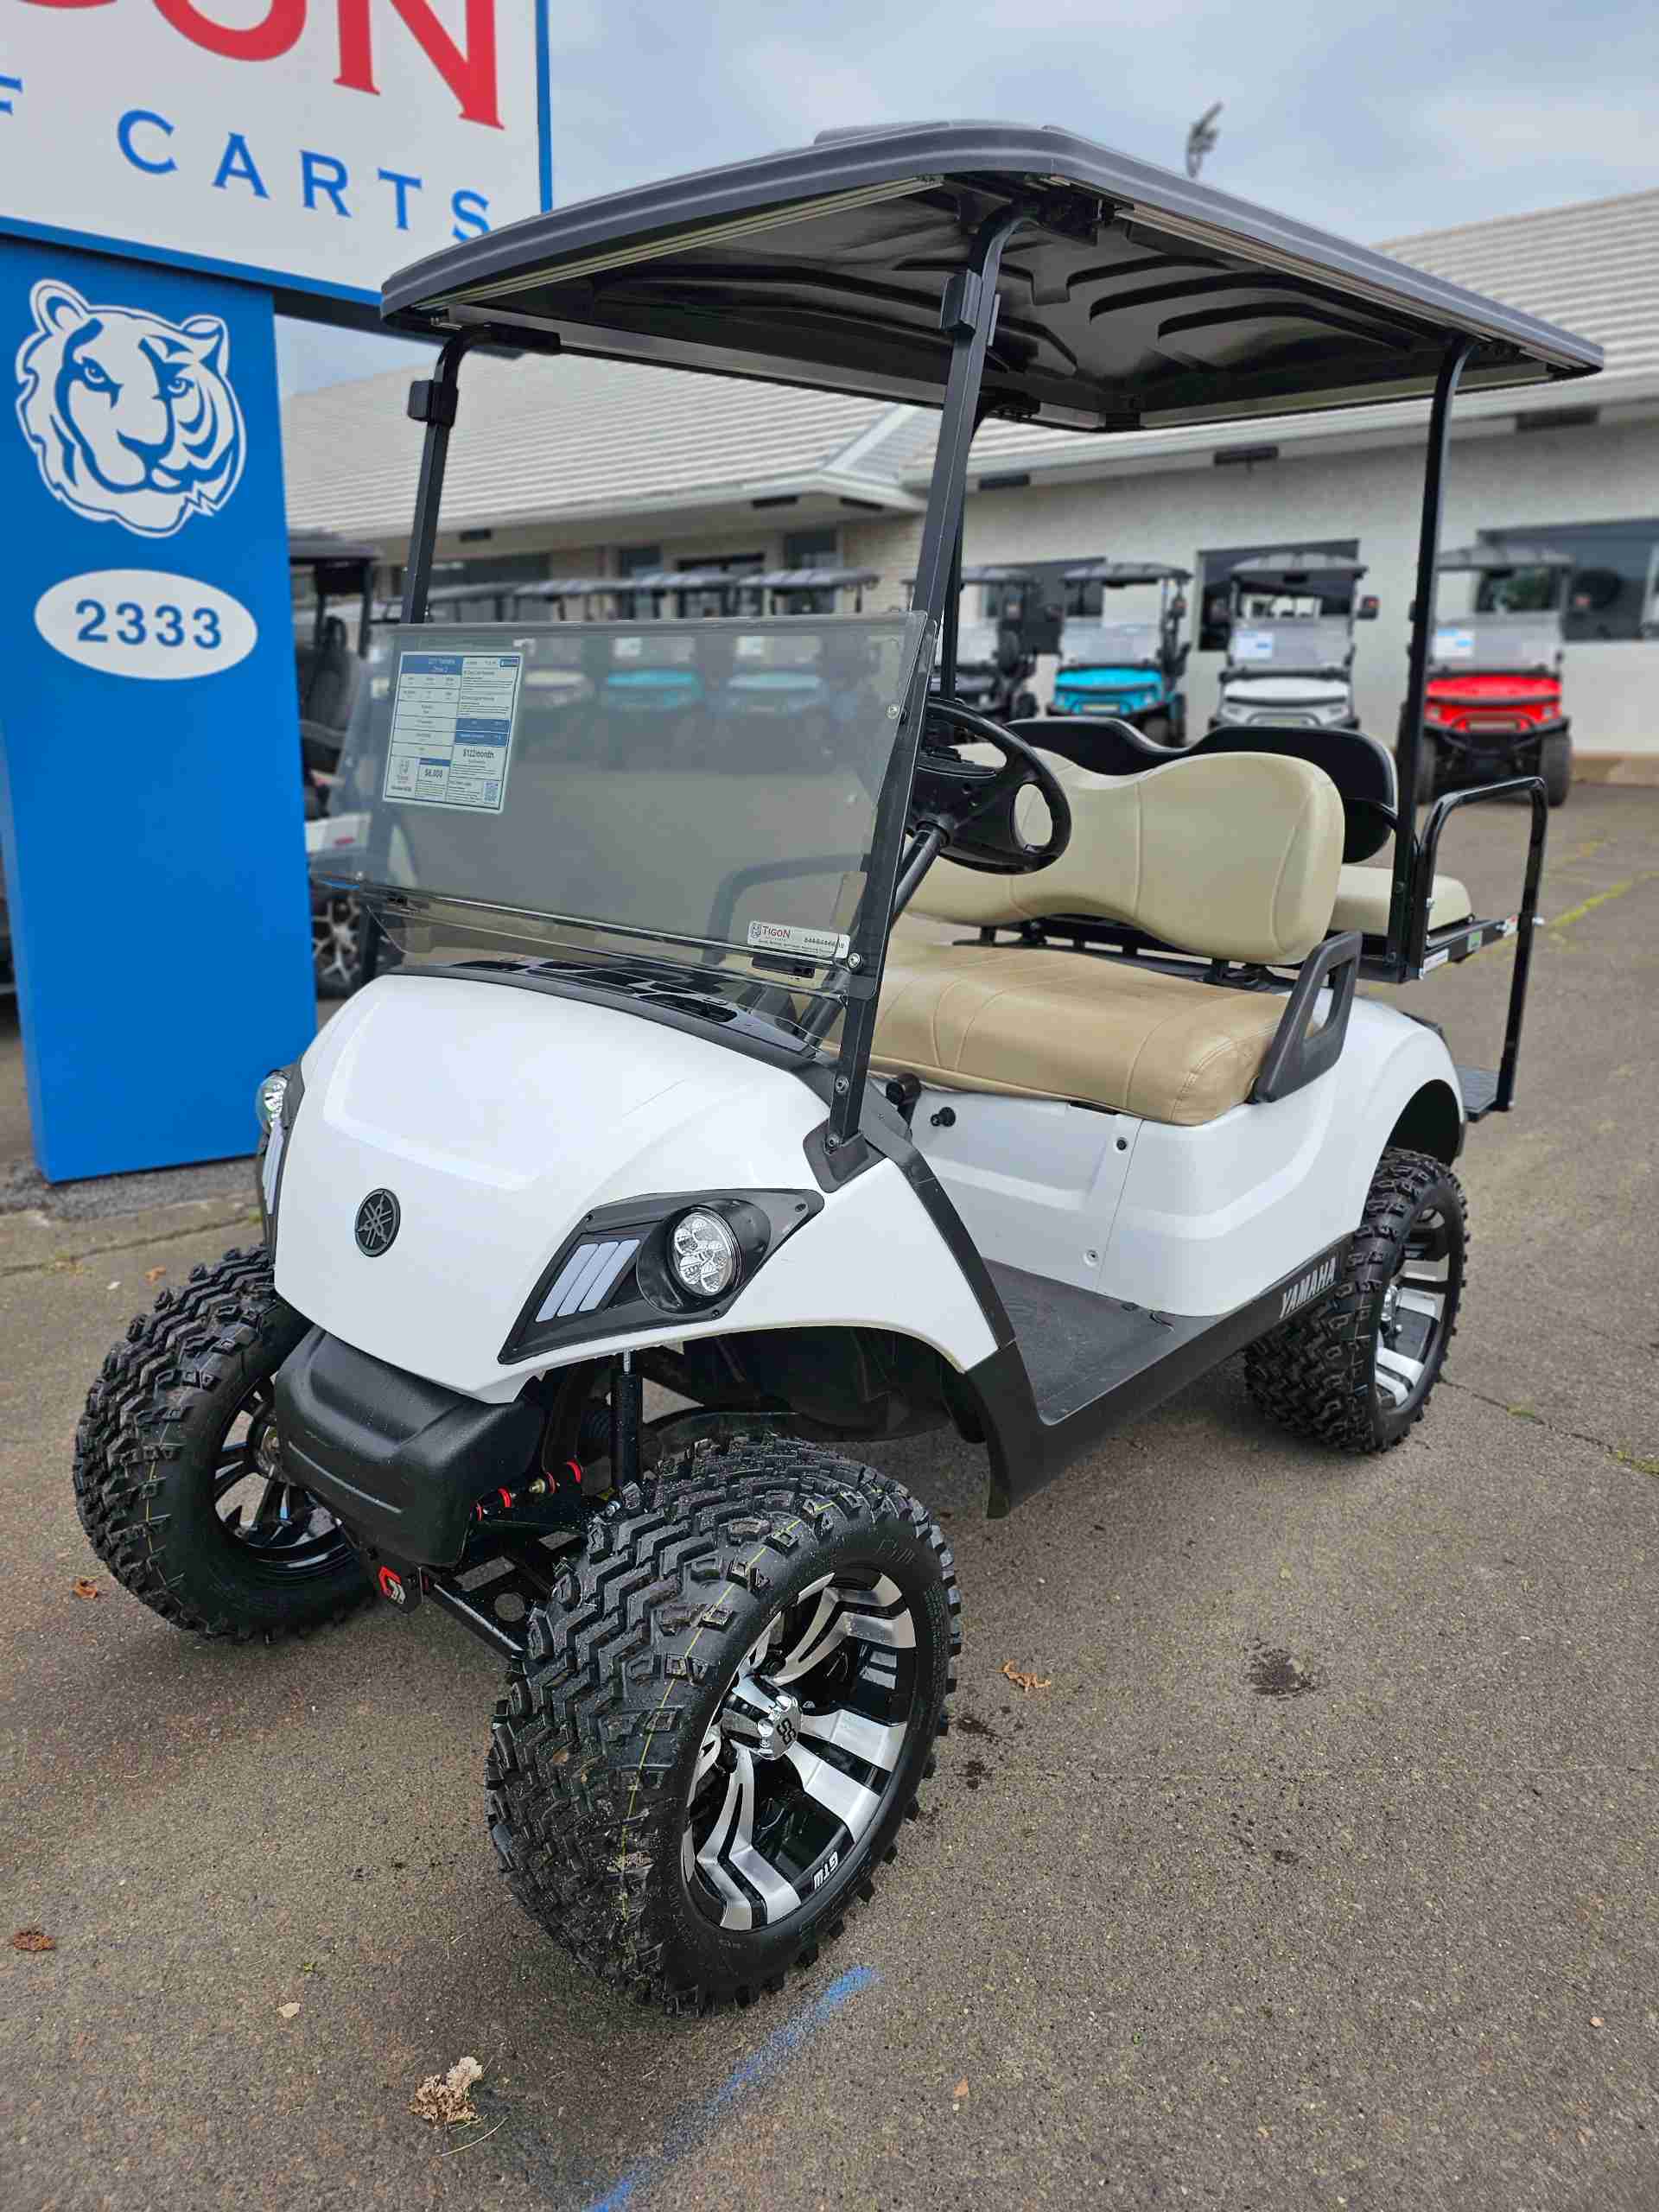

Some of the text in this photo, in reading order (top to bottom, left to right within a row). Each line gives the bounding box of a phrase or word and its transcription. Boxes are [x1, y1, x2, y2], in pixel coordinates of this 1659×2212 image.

[118, 109, 492, 243] CARTS
[75, 599, 222, 650] 2333
[1279, 1256, 1337, 1320] YAMAHA
[813, 1851, 839, 1891] GTW
